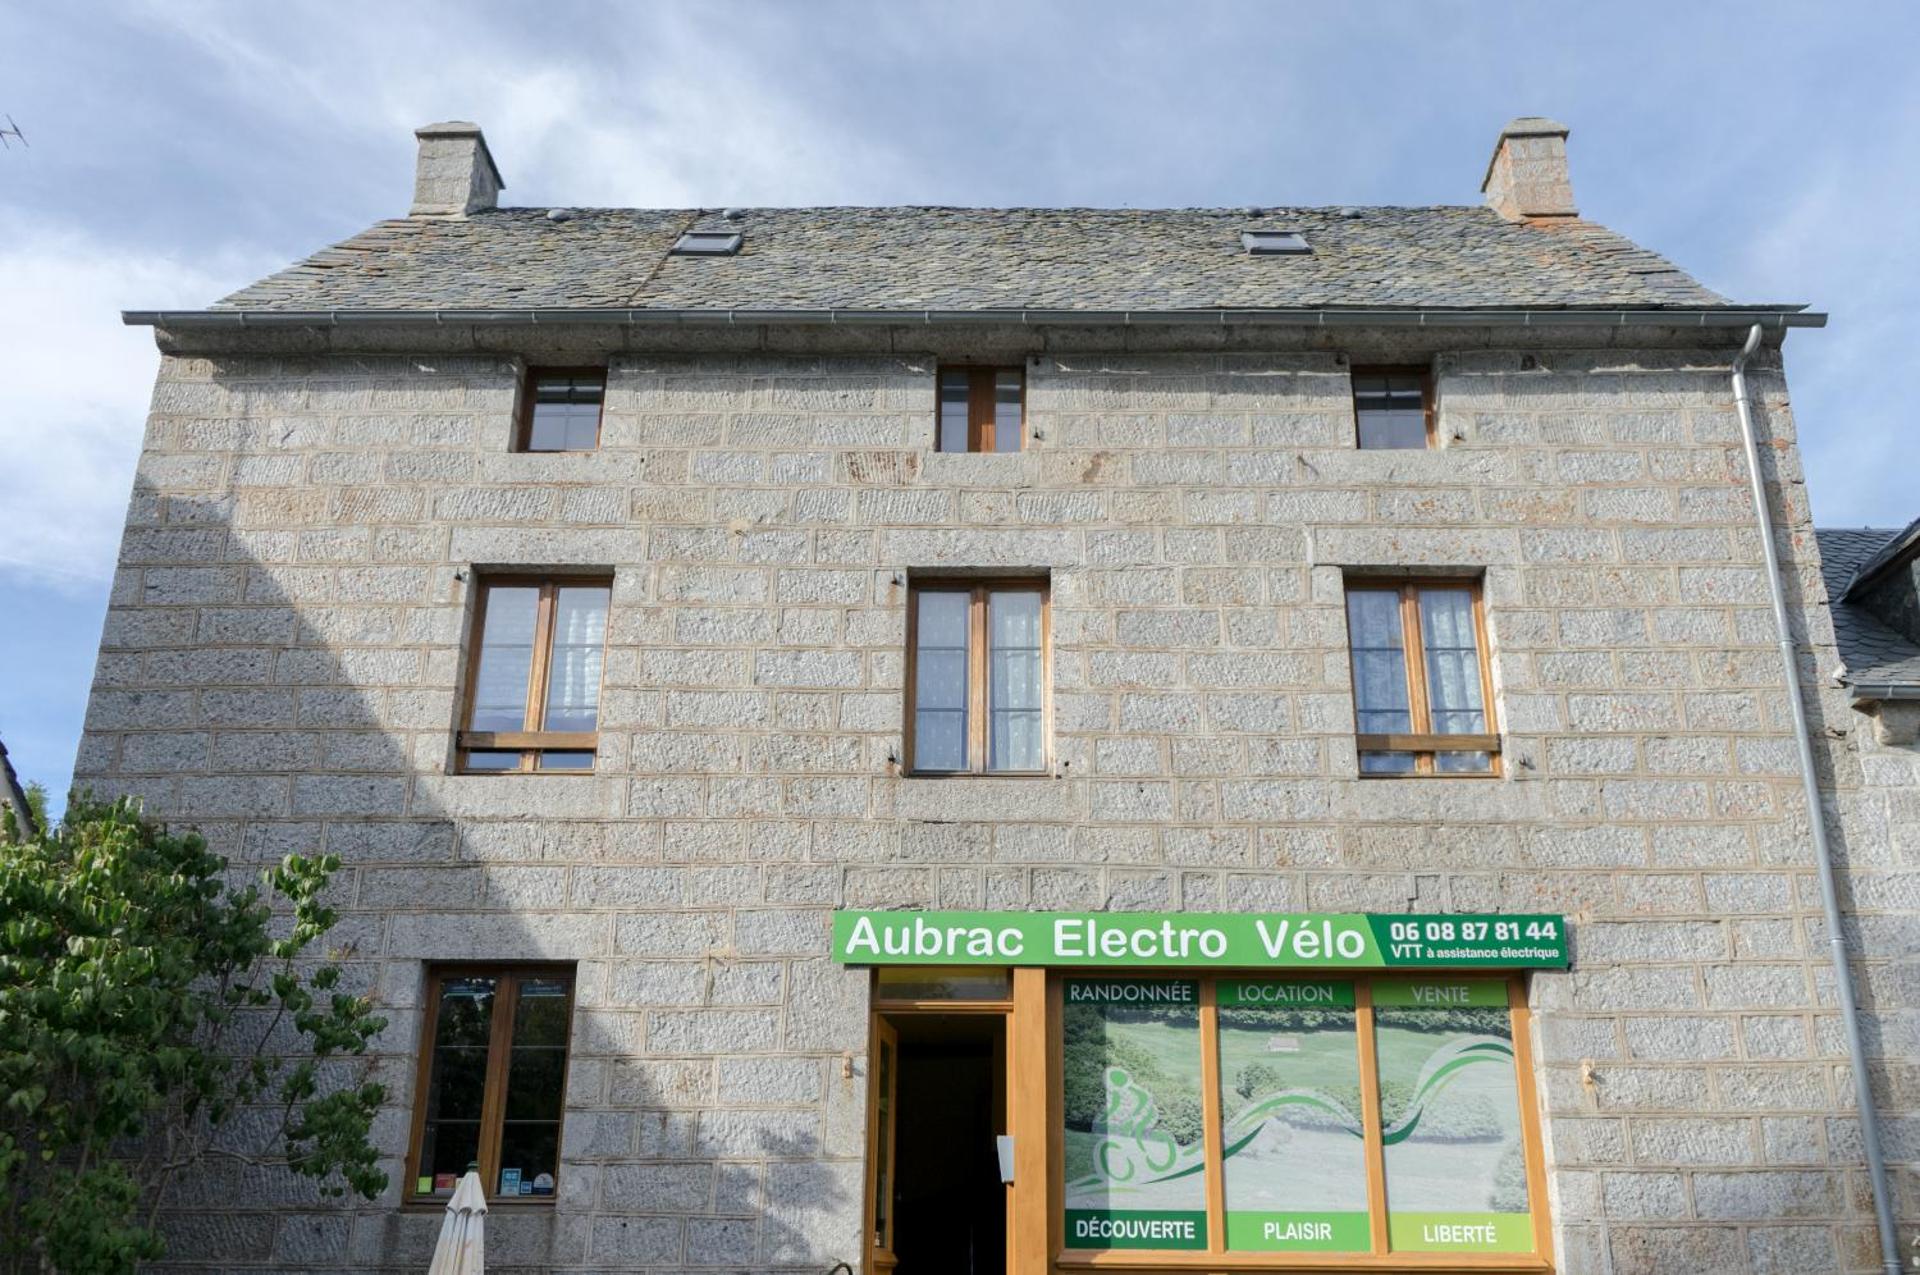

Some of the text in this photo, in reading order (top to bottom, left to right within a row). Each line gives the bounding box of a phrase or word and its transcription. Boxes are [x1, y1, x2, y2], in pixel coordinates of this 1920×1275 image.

[845, 916, 1366, 959] Aubrac Electro Vélo
[1390, 921, 1557, 941] 06 08 87 81 44
[1391, 944, 1559, 960] VTT à assistance électrique
[1070, 981, 1192, 1002] RANDONNÉE
[1237, 985, 1334, 1002] LOCATION
[1411, 985, 1471, 1002] VENTE
[1076, 1218, 1196, 1239] DÉCOUVERTE
[1264, 1222, 1332, 1240] PLAISIR
[1423, 1221, 1498, 1243] LIBERTÉ
